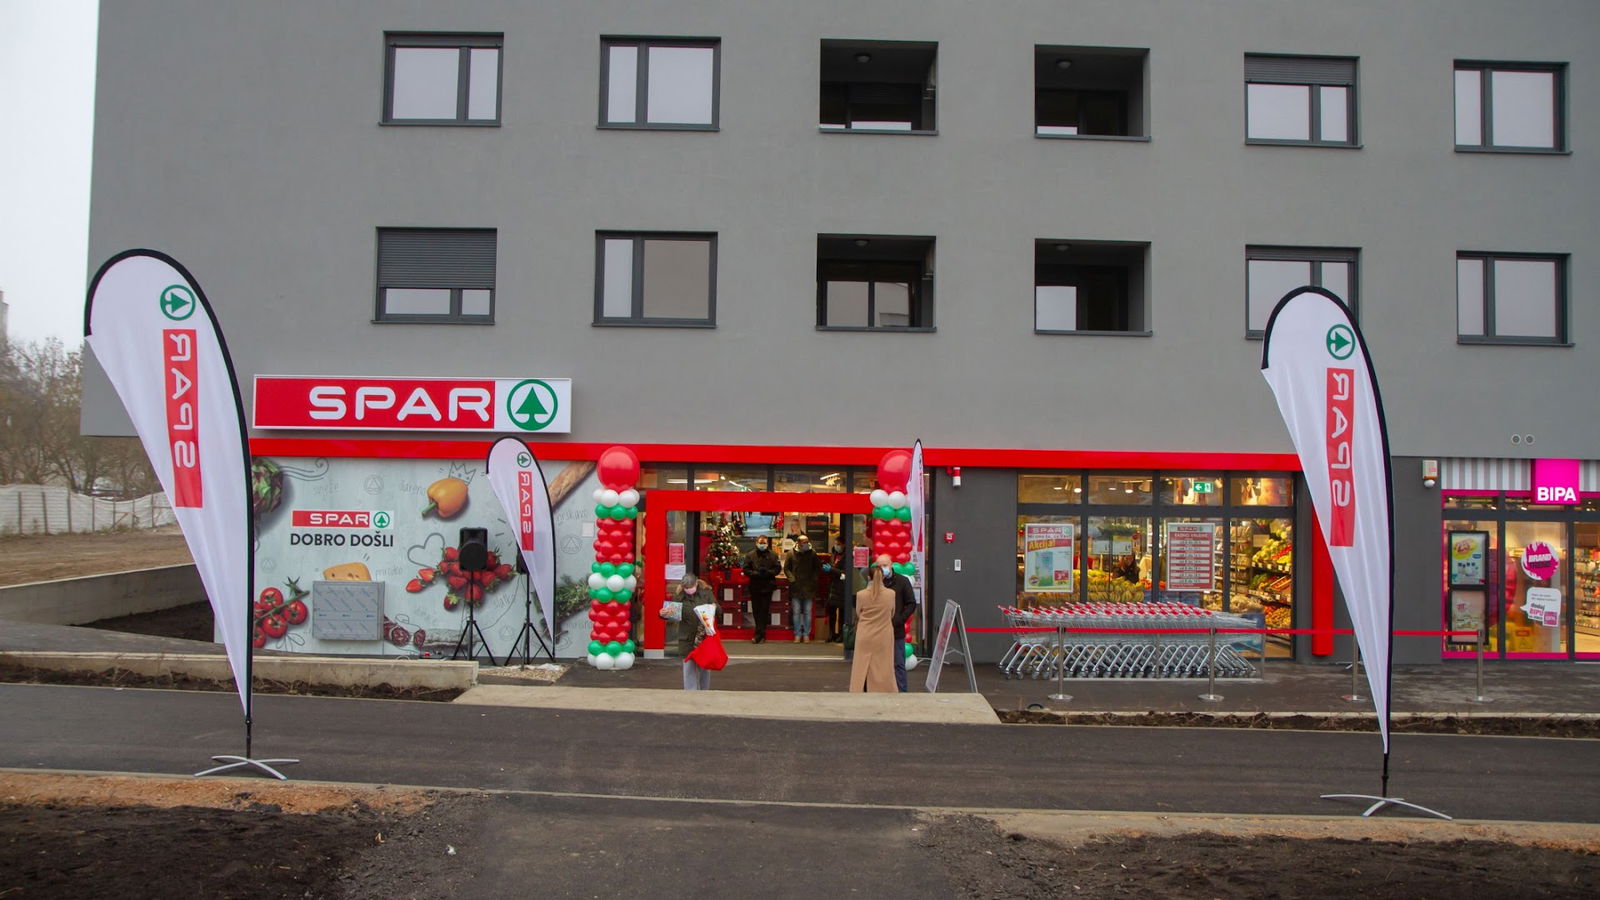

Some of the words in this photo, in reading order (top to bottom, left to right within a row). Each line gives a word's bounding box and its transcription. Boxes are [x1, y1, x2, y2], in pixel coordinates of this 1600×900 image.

[309, 385, 491, 422] SPAR
[1537, 486, 1577, 502] BIPA
[310, 513, 369, 525] SPAR
[290, 533, 346, 546] DOBRO
[350, 530, 394, 547] DOŠLI
